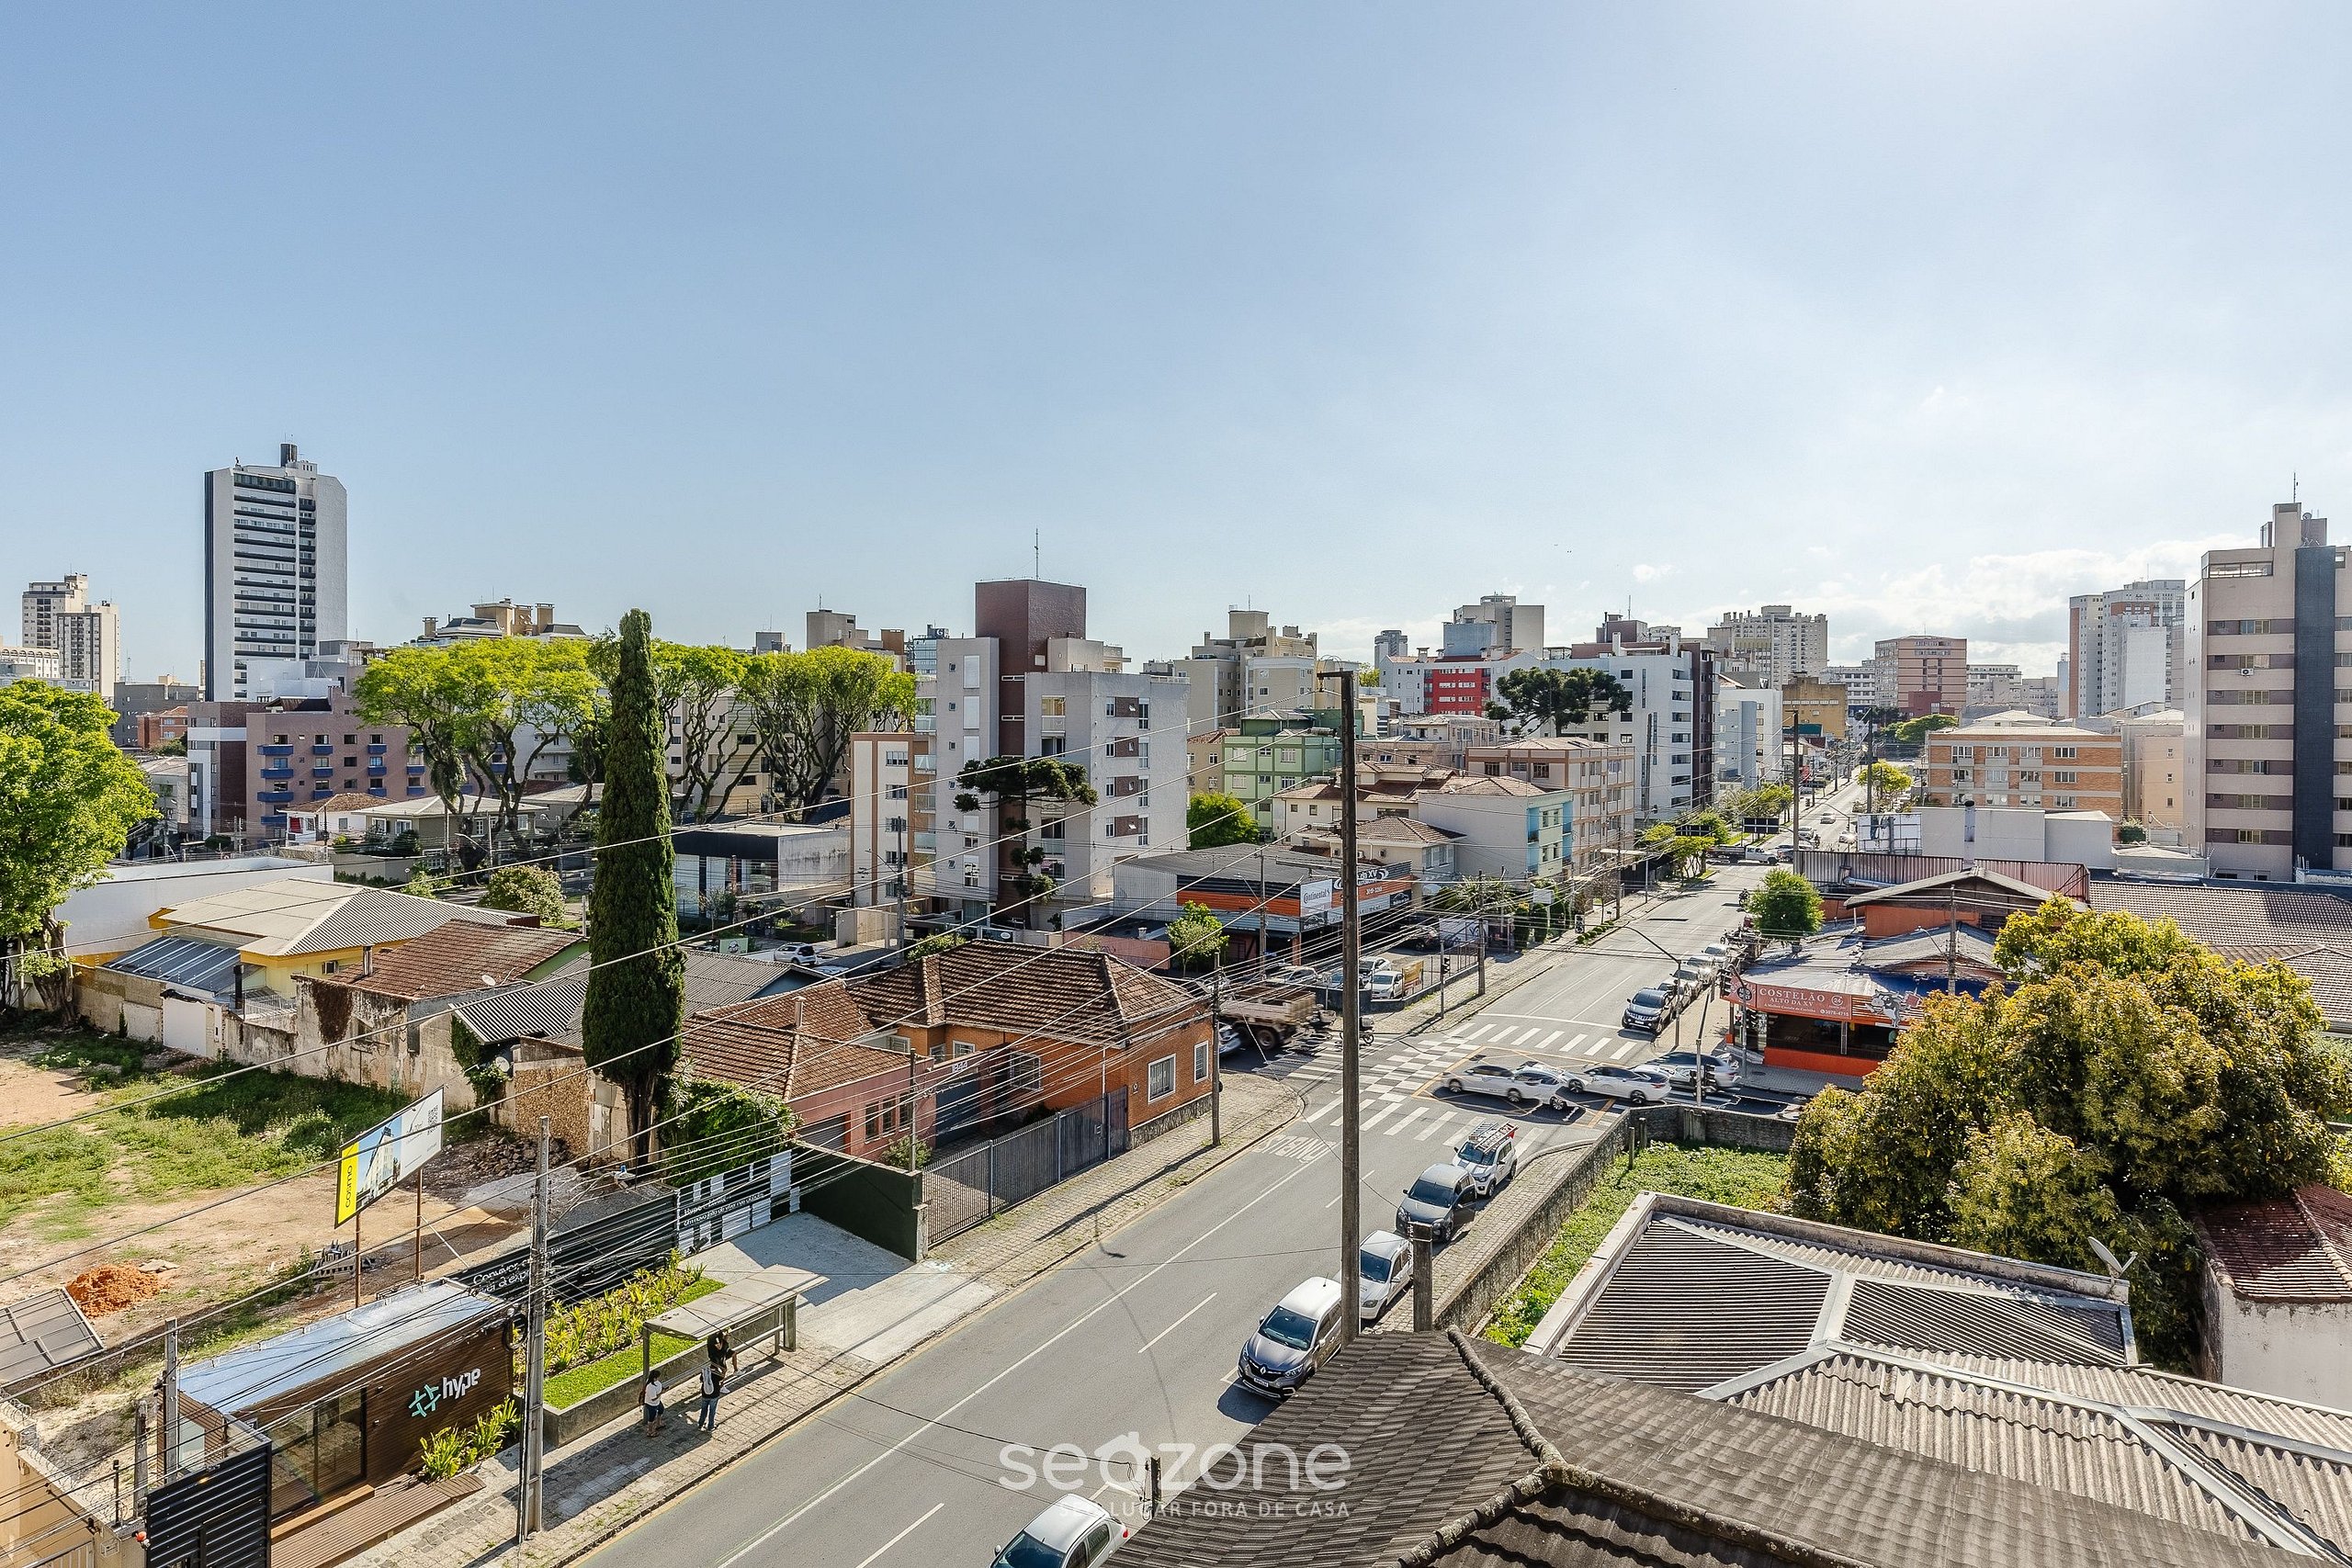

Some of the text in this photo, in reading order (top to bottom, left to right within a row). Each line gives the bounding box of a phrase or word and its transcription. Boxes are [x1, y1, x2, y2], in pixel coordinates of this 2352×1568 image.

[1368, 869, 1378, 878] XV
[1303, 889, 1327, 905] Continental
[1759, 987, 1826, 1002] COSTELÃO
